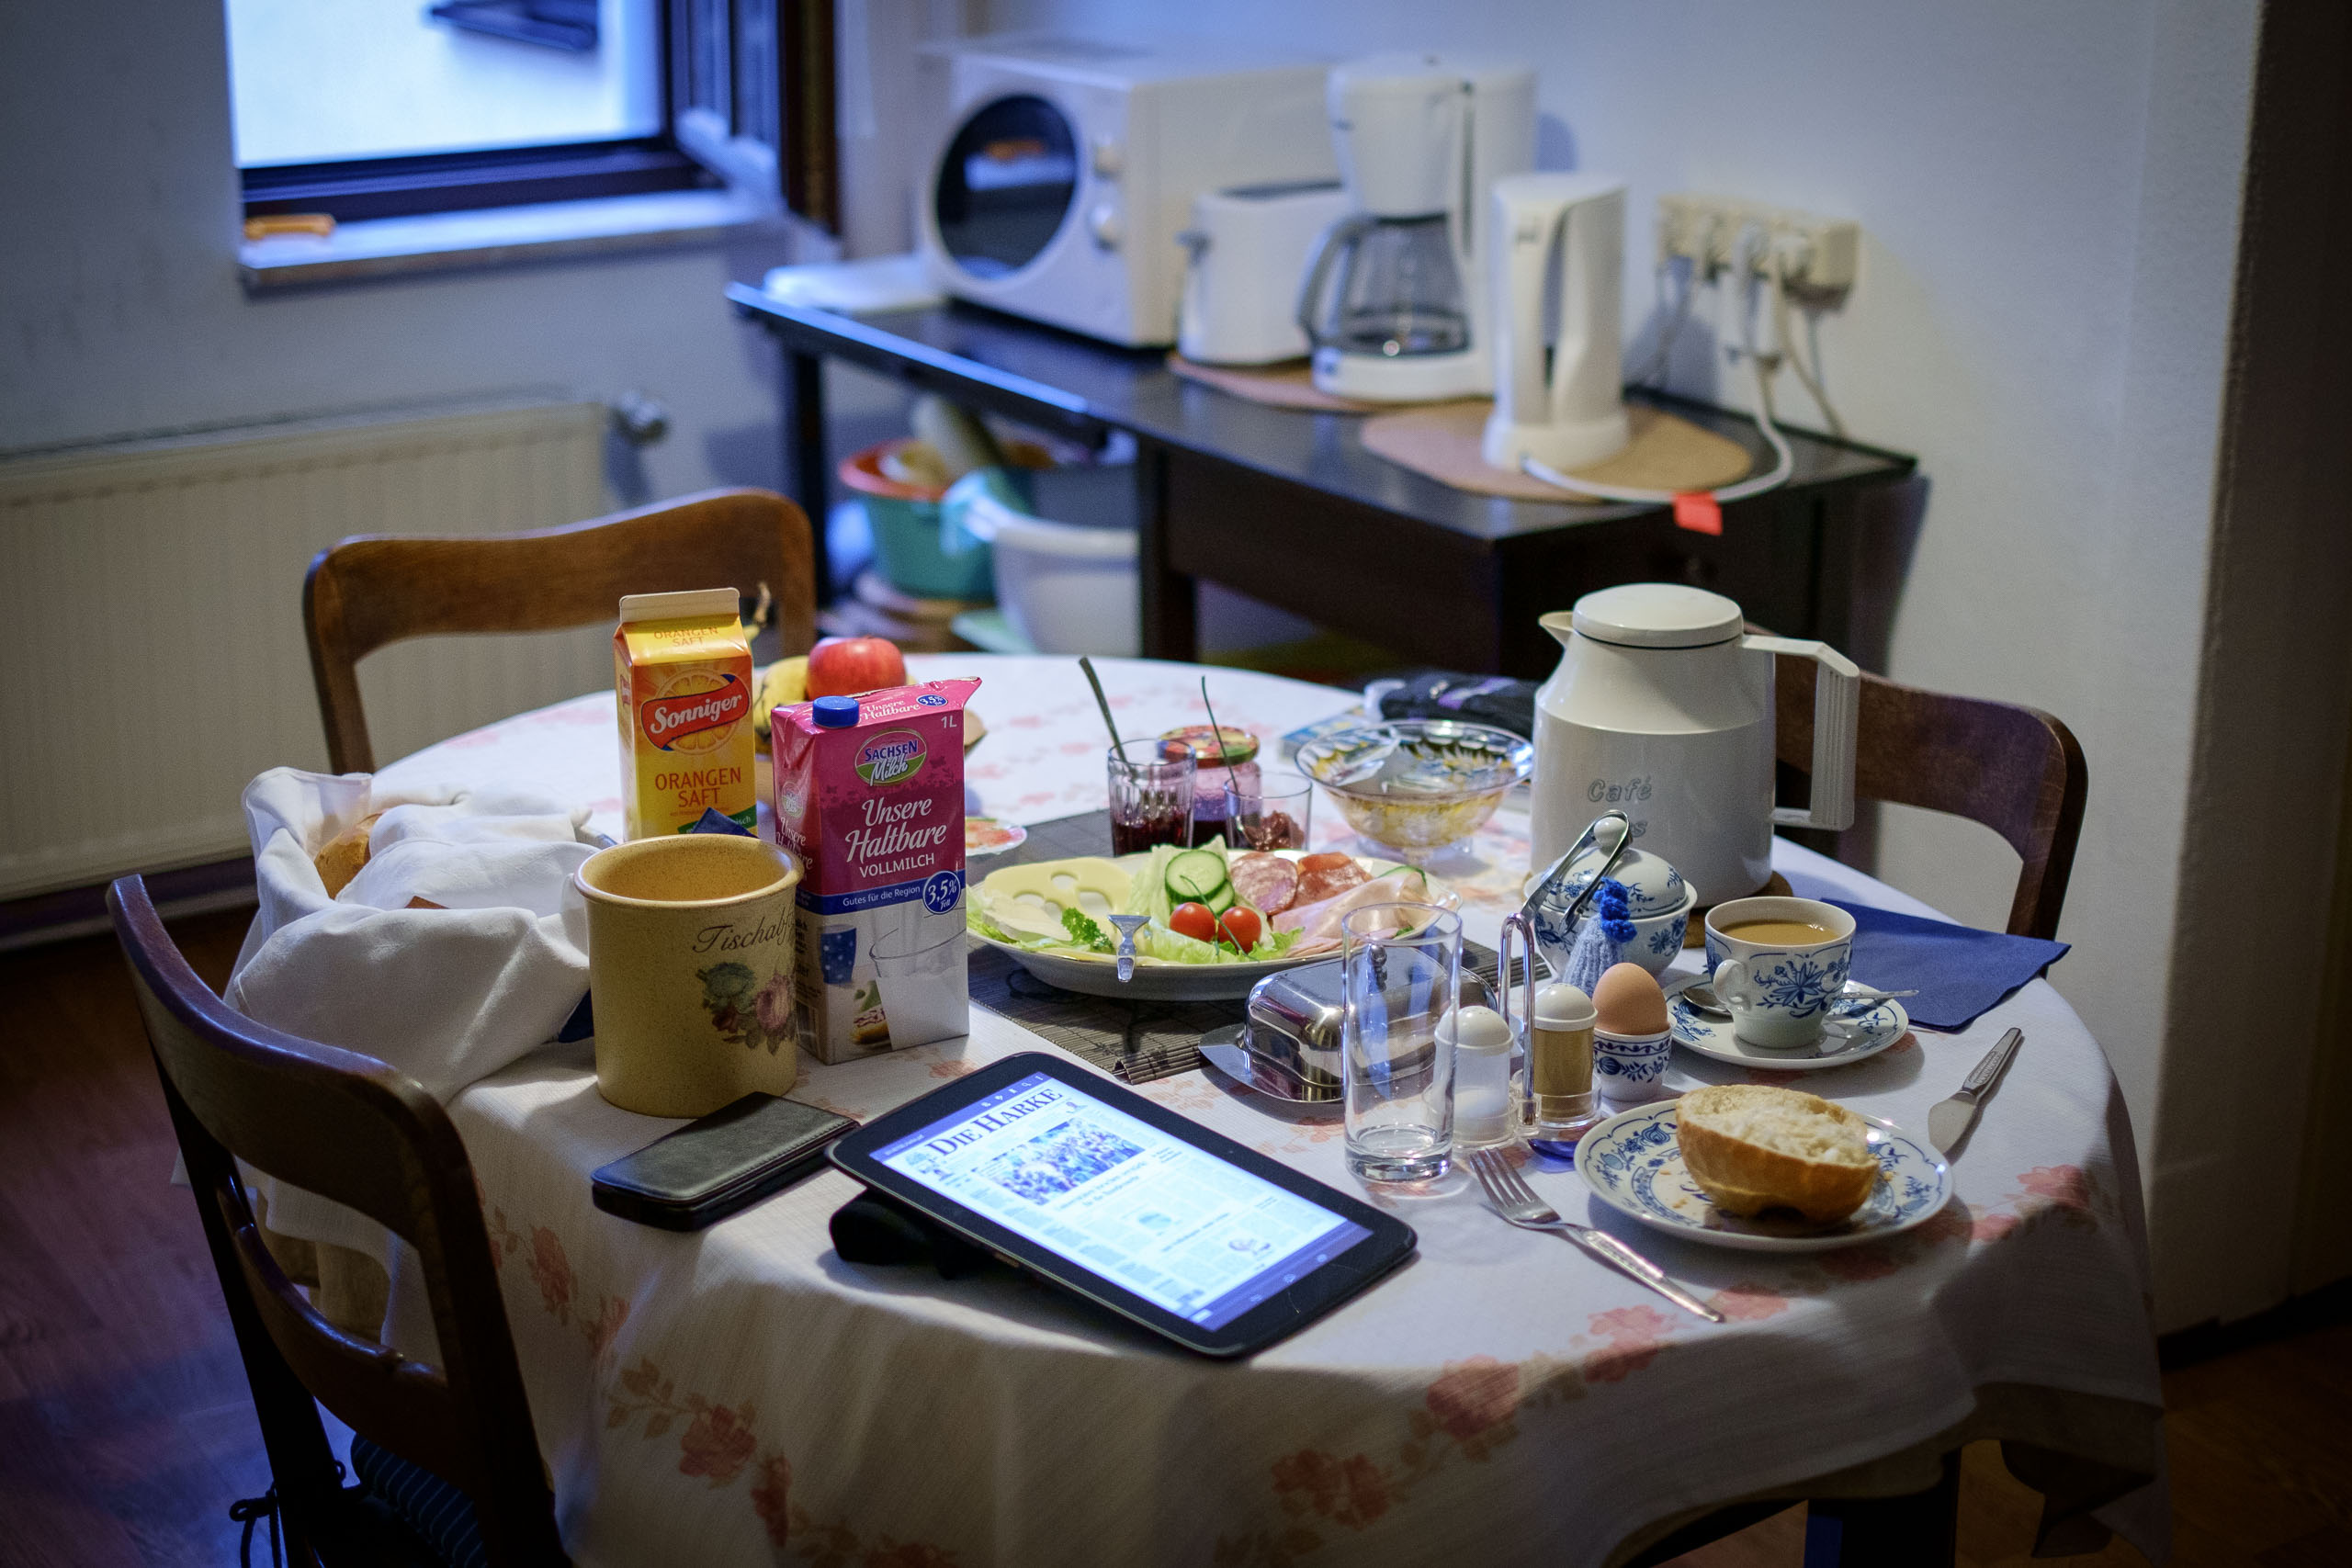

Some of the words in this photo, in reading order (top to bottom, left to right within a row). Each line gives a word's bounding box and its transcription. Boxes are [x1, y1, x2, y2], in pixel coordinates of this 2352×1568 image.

[653, 626, 719, 639] ORANGEN
[673, 636, 704, 647] SAFT
[650, 694, 742, 734] Sonniger
[858, 704, 922, 723] Haltbare
[863, 700, 905, 713] Unsere
[941, 715, 957, 728] 1L
[865, 739, 918, 762] SACHSEN
[654, 766, 741, 791] ORANGEN
[869, 753, 909, 786] Milch
[678, 787, 721, 807] SAFT
[861, 796, 933, 827] Unsere
[780, 817, 807, 847] Unsere
[844, 821, 947, 864] Haltbare
[859, 852, 935, 878] VOLLMILCH
[842, 896, 866, 907] Gutes
[867, 893, 878, 902] für
[880, 890, 893, 899] die
[894, 886, 921, 897] Region
[928, 879, 957, 906] 3,5%
[924, 1128, 984, 1156] DIE
[970, 1088, 1064, 1134] HARKE
